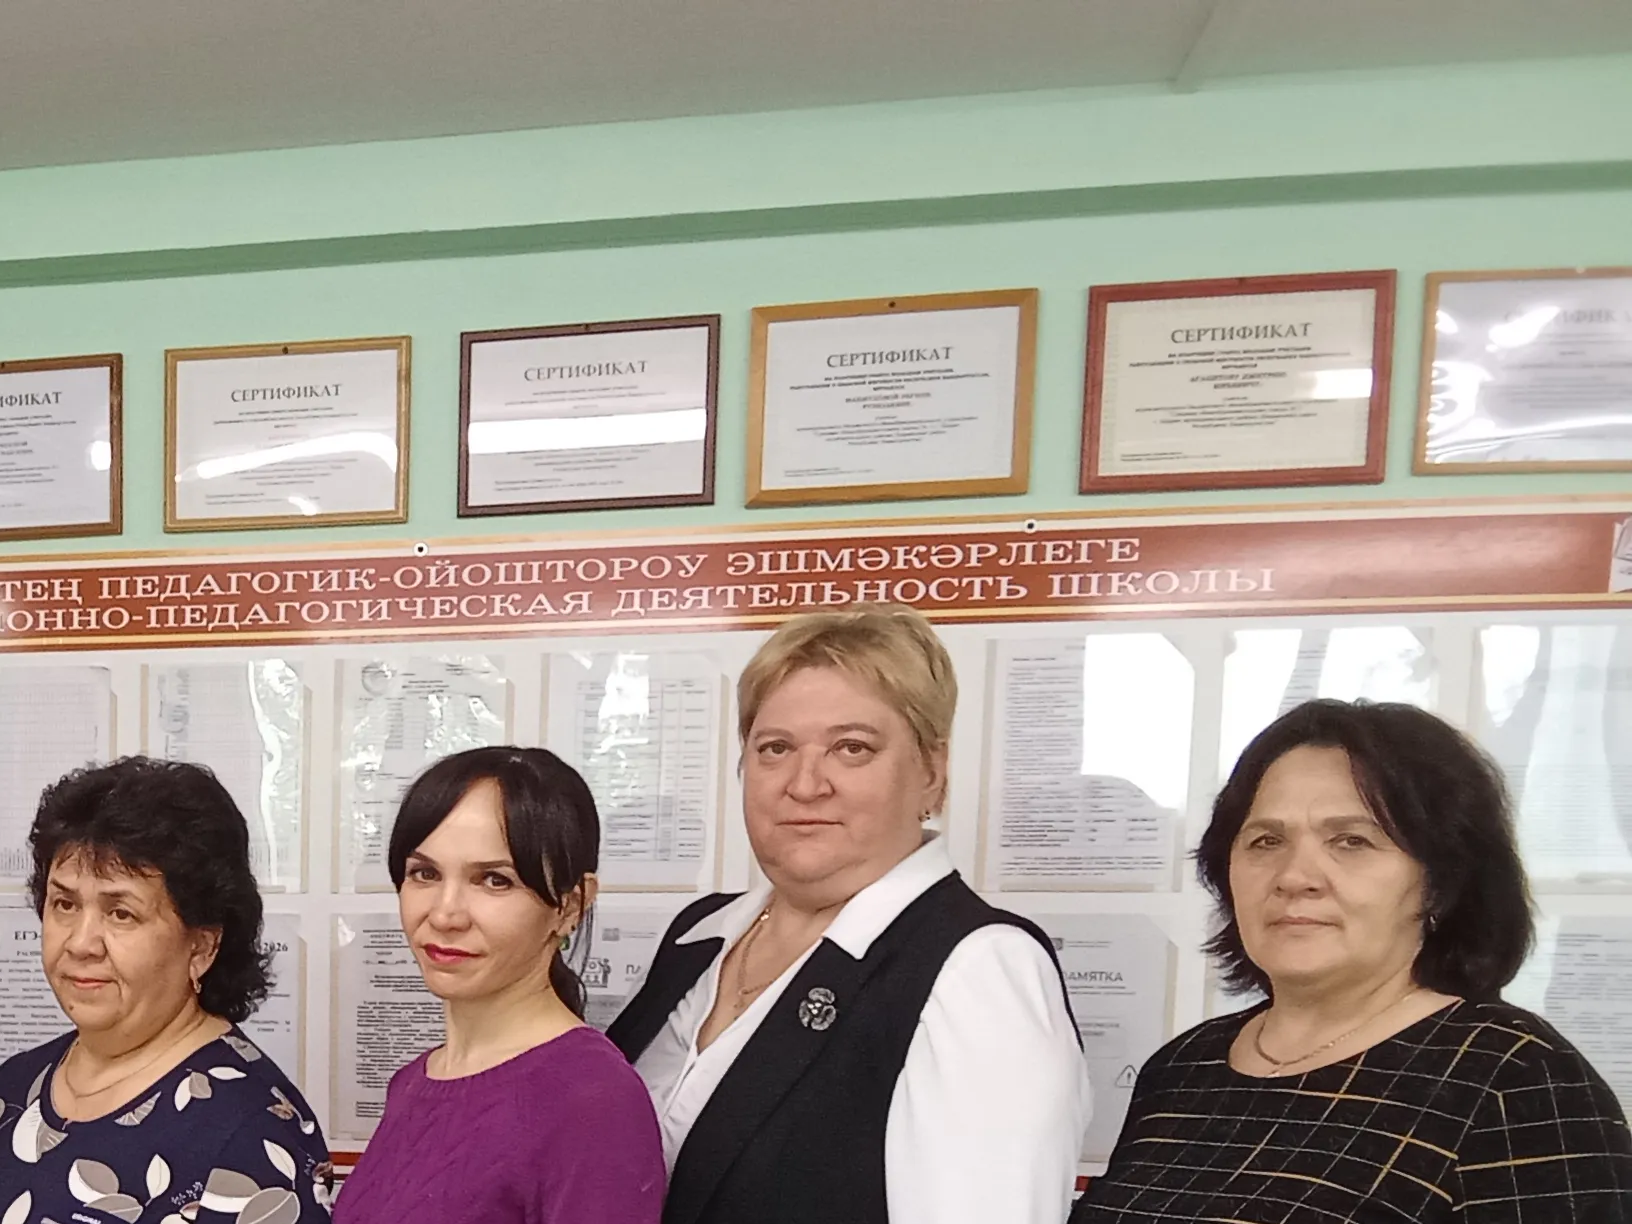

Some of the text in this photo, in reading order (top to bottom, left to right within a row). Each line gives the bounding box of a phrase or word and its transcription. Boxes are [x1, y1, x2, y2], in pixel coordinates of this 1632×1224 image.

[1170, 322, 1313, 344] СЕРТИФИКАТ
[826, 346, 954, 369] СЕРТИФИКАТ
[524, 360, 650, 382] СЕРТИФИКАТ
[230, 383, 343, 403] СЕРТИФИКАТ
[97, 553, 709, 602] ПЕДАГОГИК-ОЙОШТОРОУ
[725, 537, 1142, 578] ЭШМӘКӘРЛЕГЕ
[610, 575, 1029, 618] ДЕЯТЕЛЬНОСТЬ
[1047, 567, 1277, 599] ШКОЛЫ
